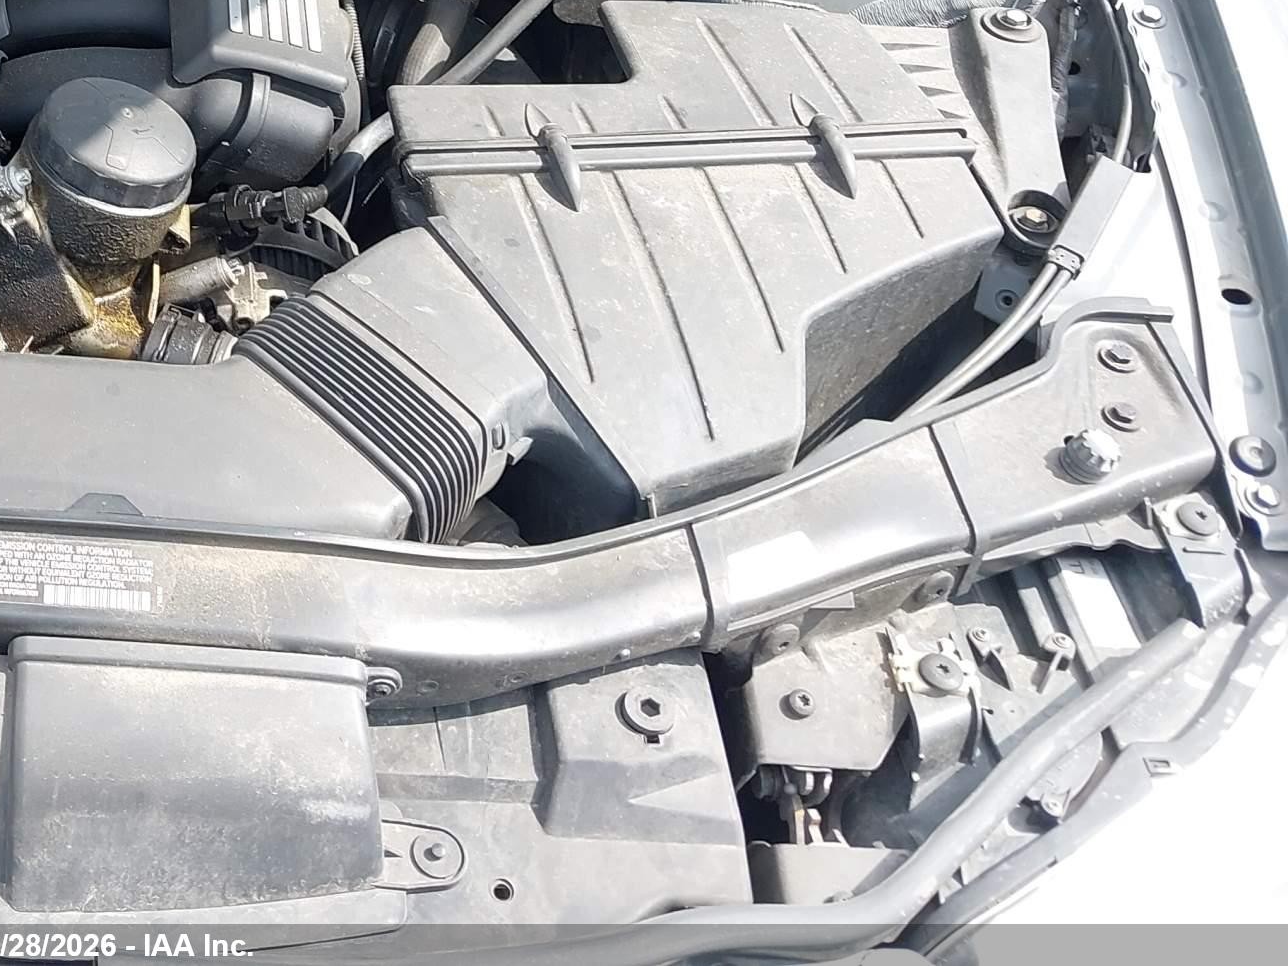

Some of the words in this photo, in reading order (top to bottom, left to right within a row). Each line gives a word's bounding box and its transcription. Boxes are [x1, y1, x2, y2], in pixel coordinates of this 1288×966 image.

[37, 543, 73, 554] CONTROL
[75, 545, 133, 557] INFORMATION
[5, 558, 19, 566] THE
[20, 559, 50, 568] VEHICLE
[50, 561, 86, 571] EMISSION
[87, 563, 121, 573] CONTROL
[14, 550, 33, 559] WITH
[34, 552, 45, 560] AN
[46, 553, 72, 562] OZONE
[73, 554, 115, 564] REDUCTION
[116, 557, 153, 567] RADIATOR
[9, 565, 41, 576] WITHOUT
[41, 567, 85, 578] EQUIVALENT
[13, 574, 24, 582] OF
[38, 576, 78, 587] POLLUTION
